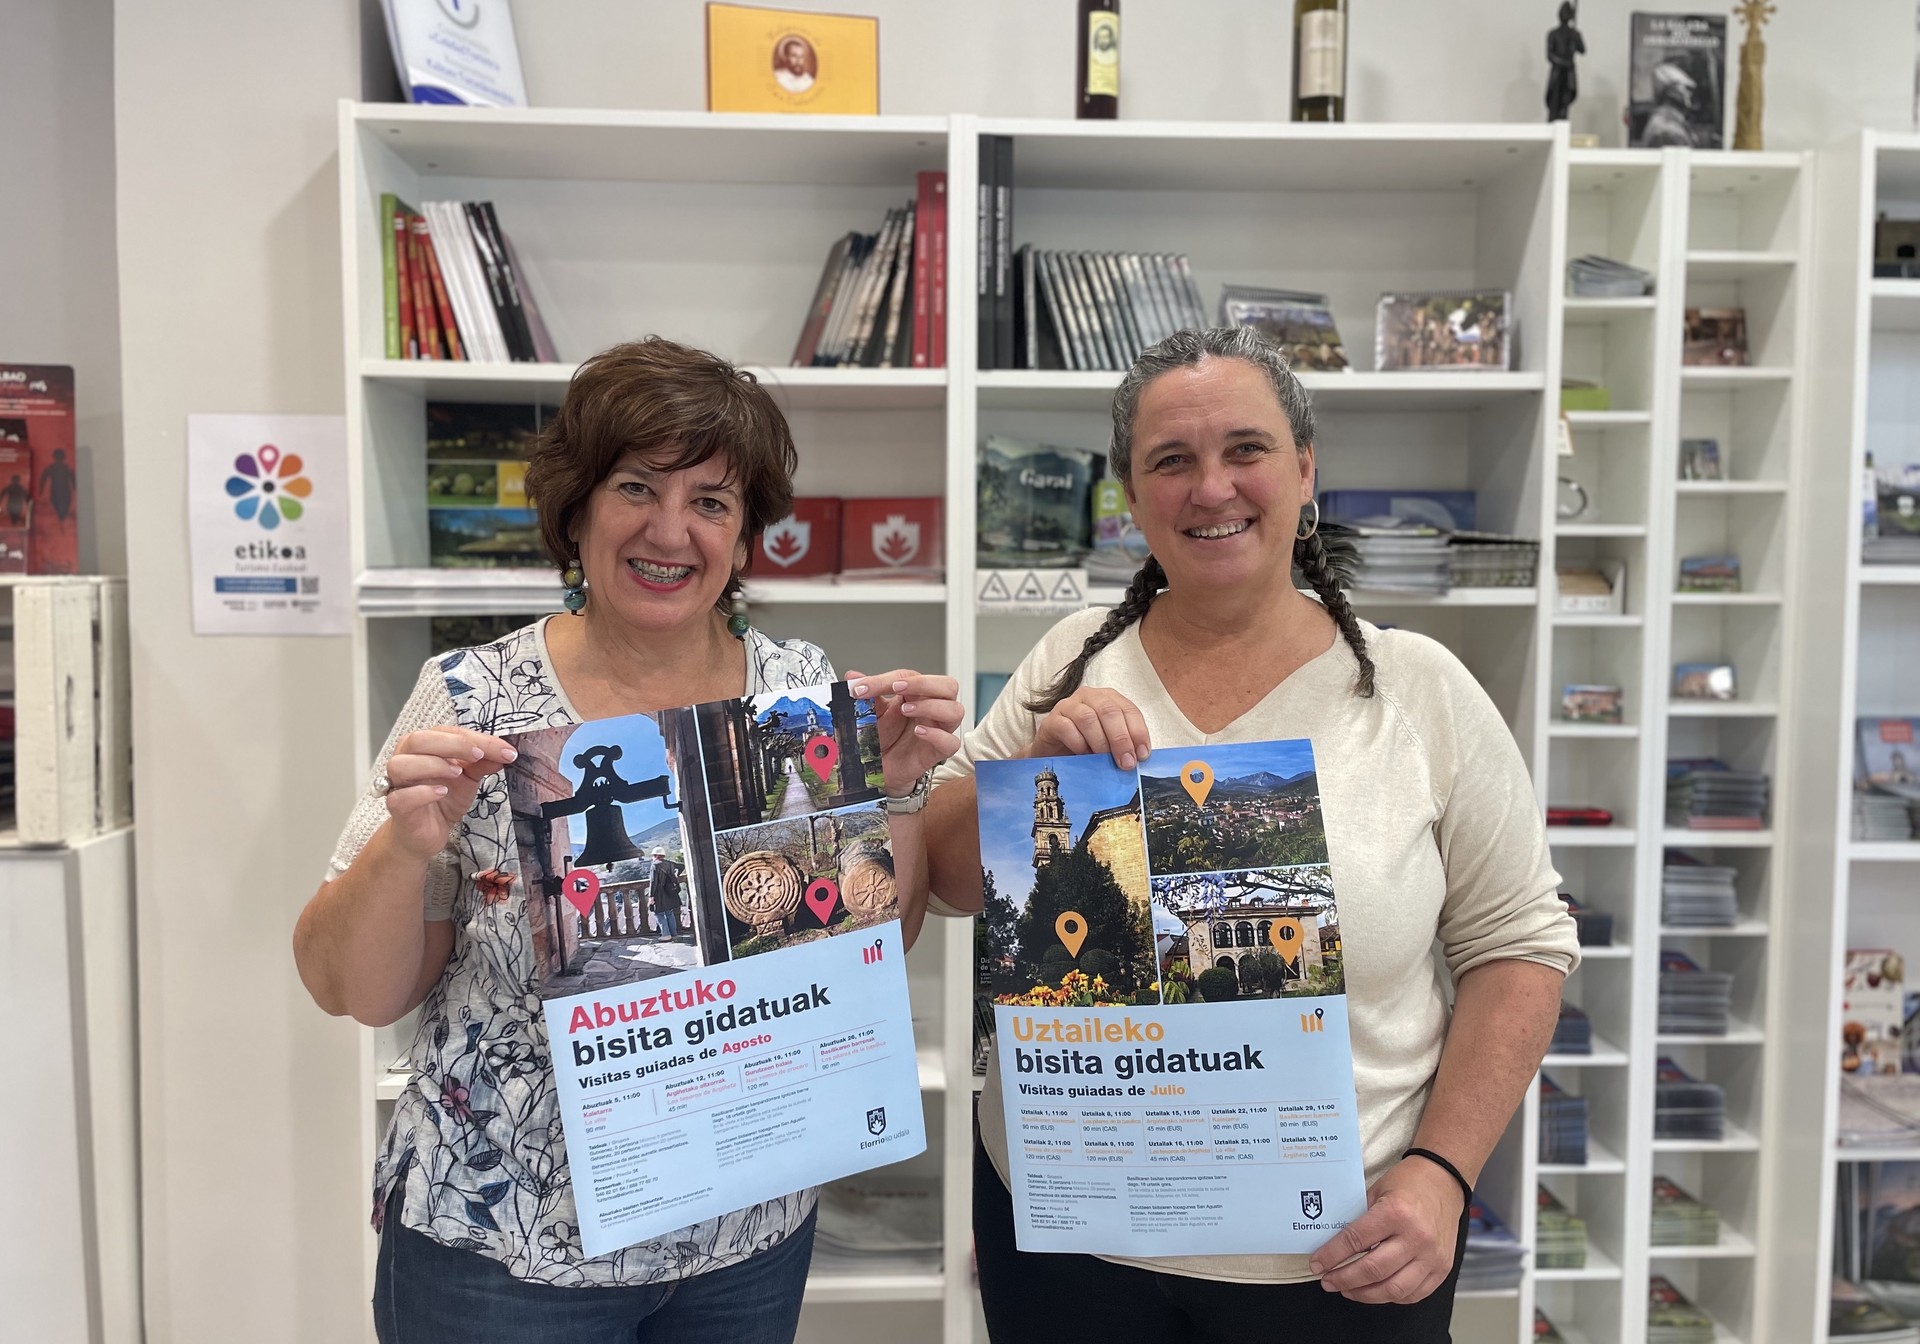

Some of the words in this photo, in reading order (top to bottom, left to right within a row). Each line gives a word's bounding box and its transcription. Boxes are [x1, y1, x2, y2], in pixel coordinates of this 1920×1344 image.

[1019, 469, 1073, 490] Garai
[235, 539, 306, 559] etikoa
[569, 979, 736, 1034] Abuztuko
[572, 1027, 673, 1066] bisita
[685, 983, 831, 1045] gidatuak
[1012, 1016, 1165, 1043] Uztaileko
[820, 1037, 846, 1048] Abuztuak
[858, 1029, 874, 1037] 11:00
[578, 1071, 631, 1089] Visitas
[636, 1055, 694, 1078] guiadas
[699, 1048, 717, 1059] de
[722, 1035, 771, 1054] Agosto
[744, 1058, 772, 1069] Abuztuak
[785, 1049, 801, 1057] 11:00
[1015, 1047, 1103, 1075] bisita
[1114, 1044, 1265, 1080] gidatuak
[665, 1079, 694, 1090] Abuztuak
[707, 1070, 724, 1078] 11:00
[582, 1099, 613, 1110] Abuztuak
[623, 1092, 640, 1100] 11:00
[1018, 1083, 1064, 1096] Visitas
[1068, 1084, 1123, 1099] guiadas
[1127, 1084, 1146, 1096] de
[1150, 1083, 1186, 1096] Julio
[860, 1135, 892, 1150] Elorrioko
[1292, 1221, 1330, 1230] Elorrioko
